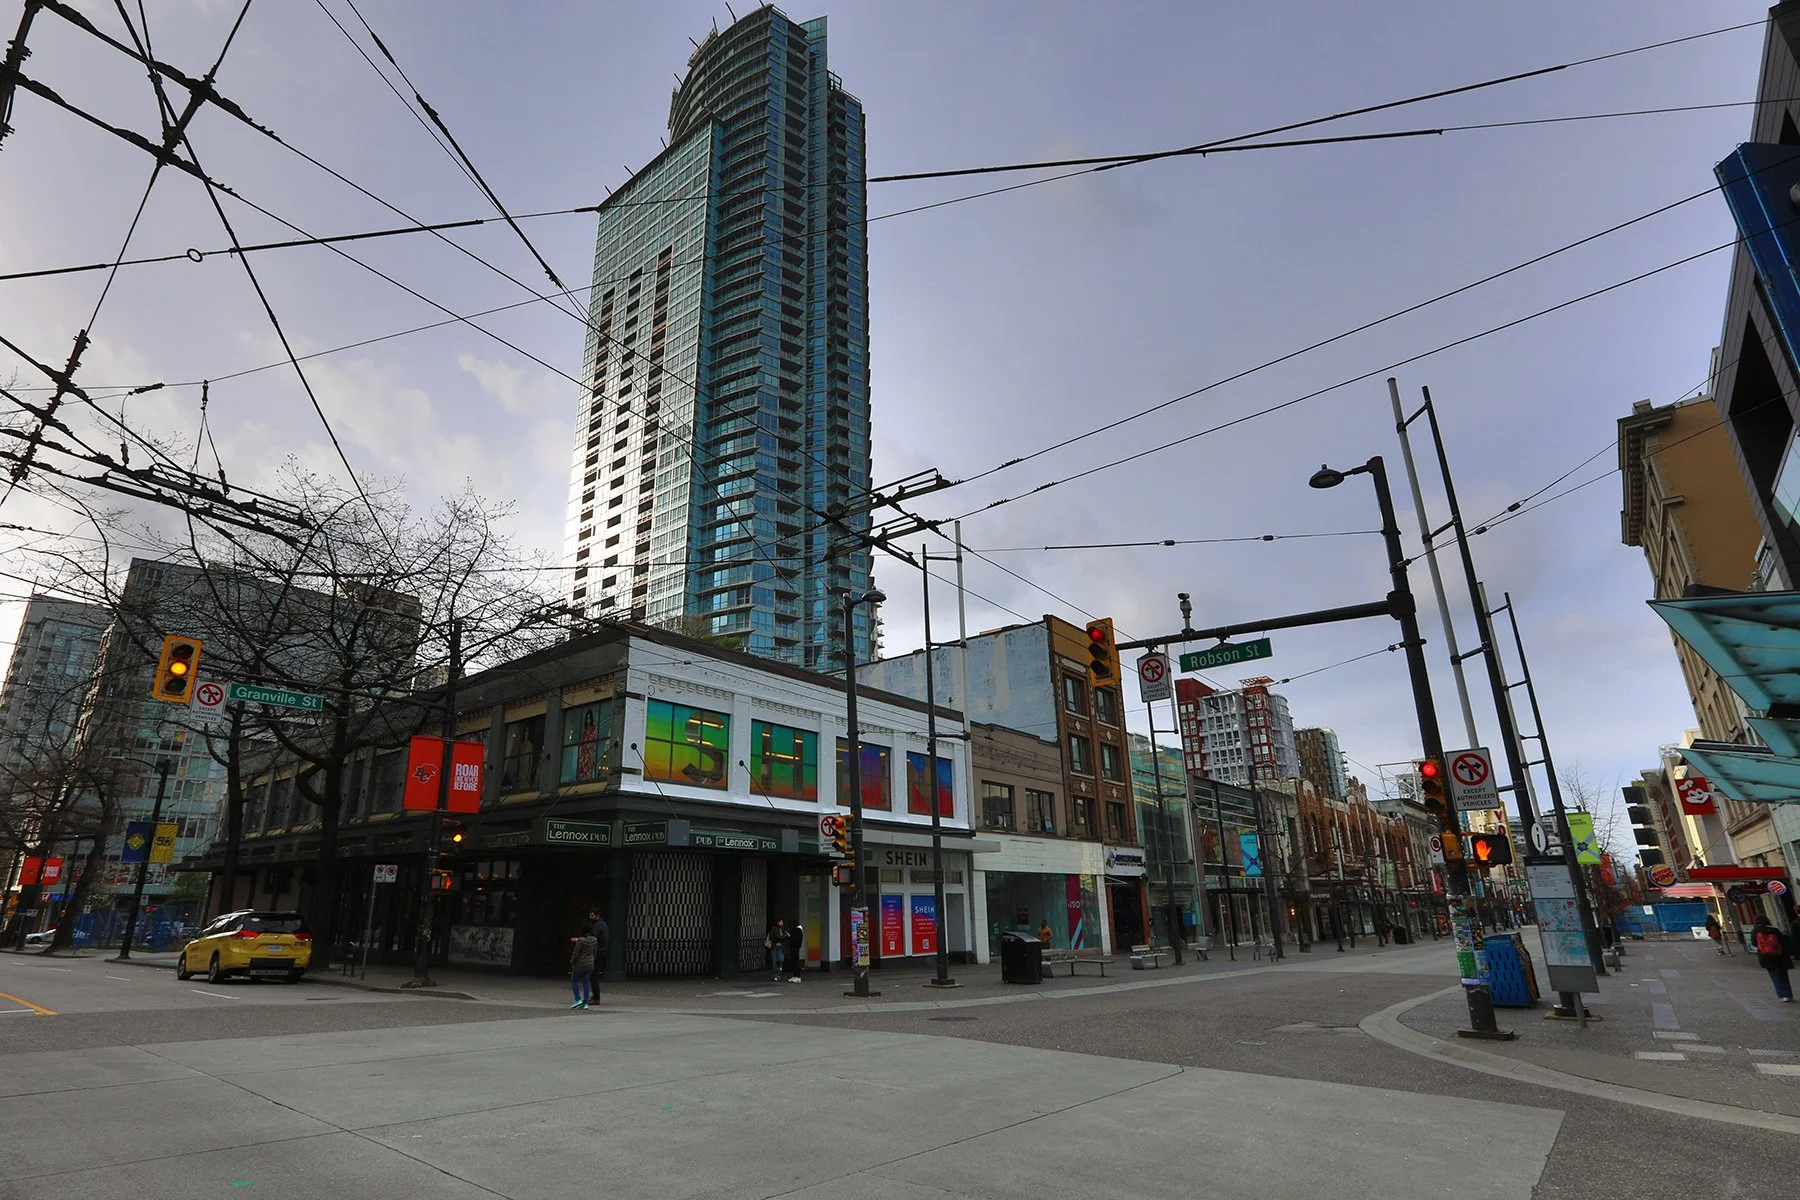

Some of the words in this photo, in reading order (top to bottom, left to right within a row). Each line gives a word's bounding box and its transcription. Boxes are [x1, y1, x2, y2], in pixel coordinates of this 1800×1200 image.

[1190, 650, 1240, 669] Robson
[1245, 643, 1260, 658] St
[236, 686, 296, 705] Granville
[302, 696, 318, 708] St
[455, 763, 479, 777] ROAR
[453, 782, 478, 791] BEFORE
[1463, 787, 1487, 795] EXCEPT
[1456, 793, 1496, 801] AUTHORIZED
[549, 829, 589, 841] Lennox
[590, 833, 608, 842] PUB
[625, 832, 651, 843] Lennox
[651, 831, 665, 841] PUB
[696, 836, 713, 845] PUB
[724, 838, 754, 848] Lennox
[762, 841, 777, 849] PUB
[886, 850, 928, 866] SHEIN
[1654, 871, 1675, 883] KING
[914, 906, 935, 914] SHEIN
